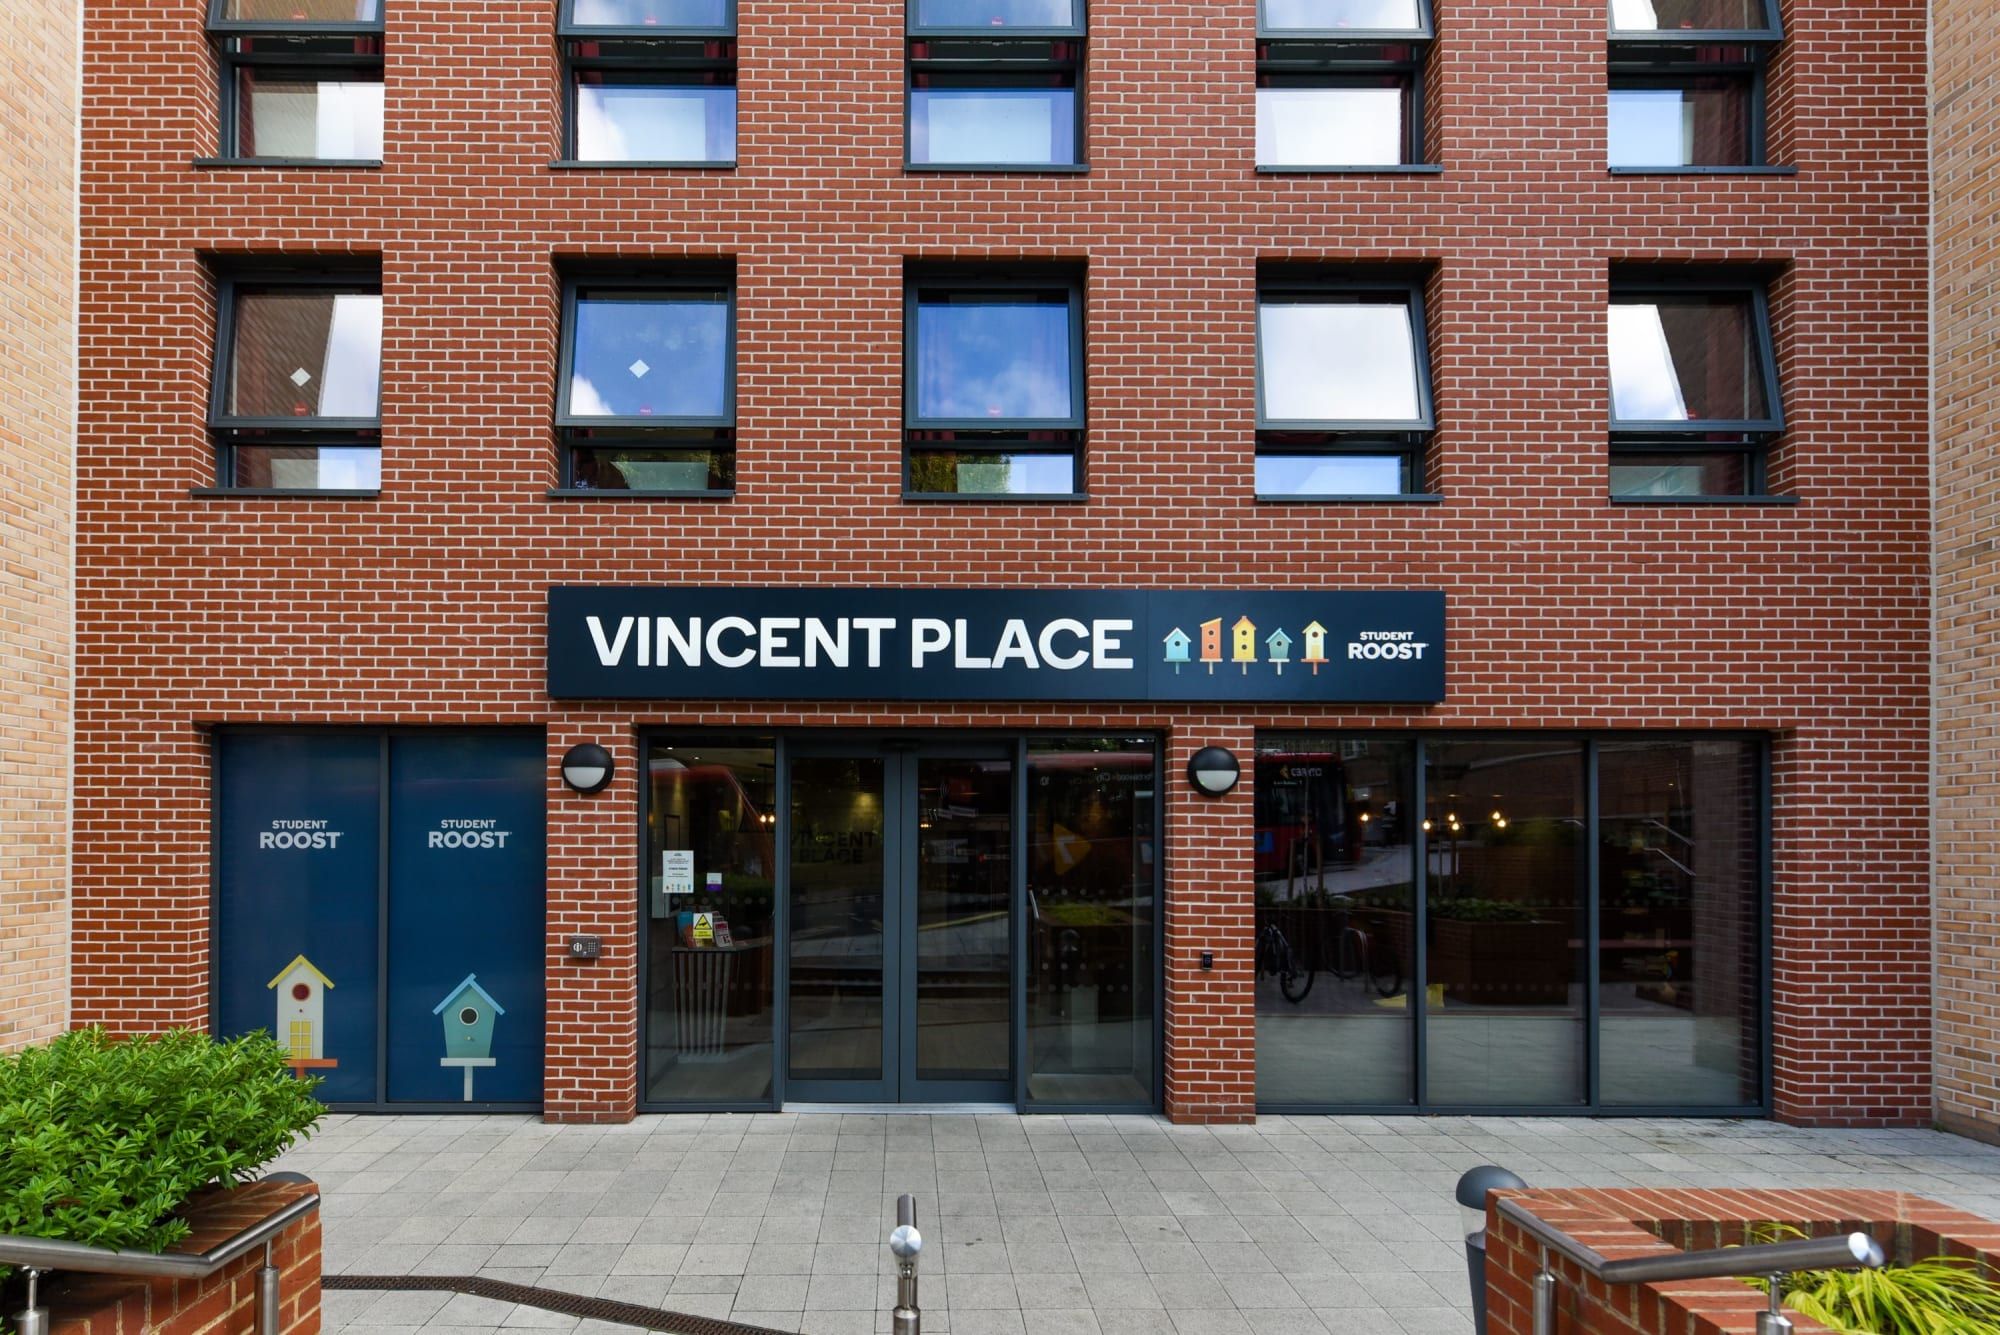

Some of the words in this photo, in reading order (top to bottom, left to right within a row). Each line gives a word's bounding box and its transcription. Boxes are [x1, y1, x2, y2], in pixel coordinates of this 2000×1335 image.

[586, 616, 896, 667] VINCENT
[912, 618, 1133, 669] PLACE
[1360, 632, 1414, 640] STUDENT
[1348, 643, 1429, 659] ROOST
[272, 820, 327, 829] STUDENT
[441, 820, 496, 828] STUDENT
[260, 832, 344, 849] ROOST
[429, 831, 512, 848] ROOST
